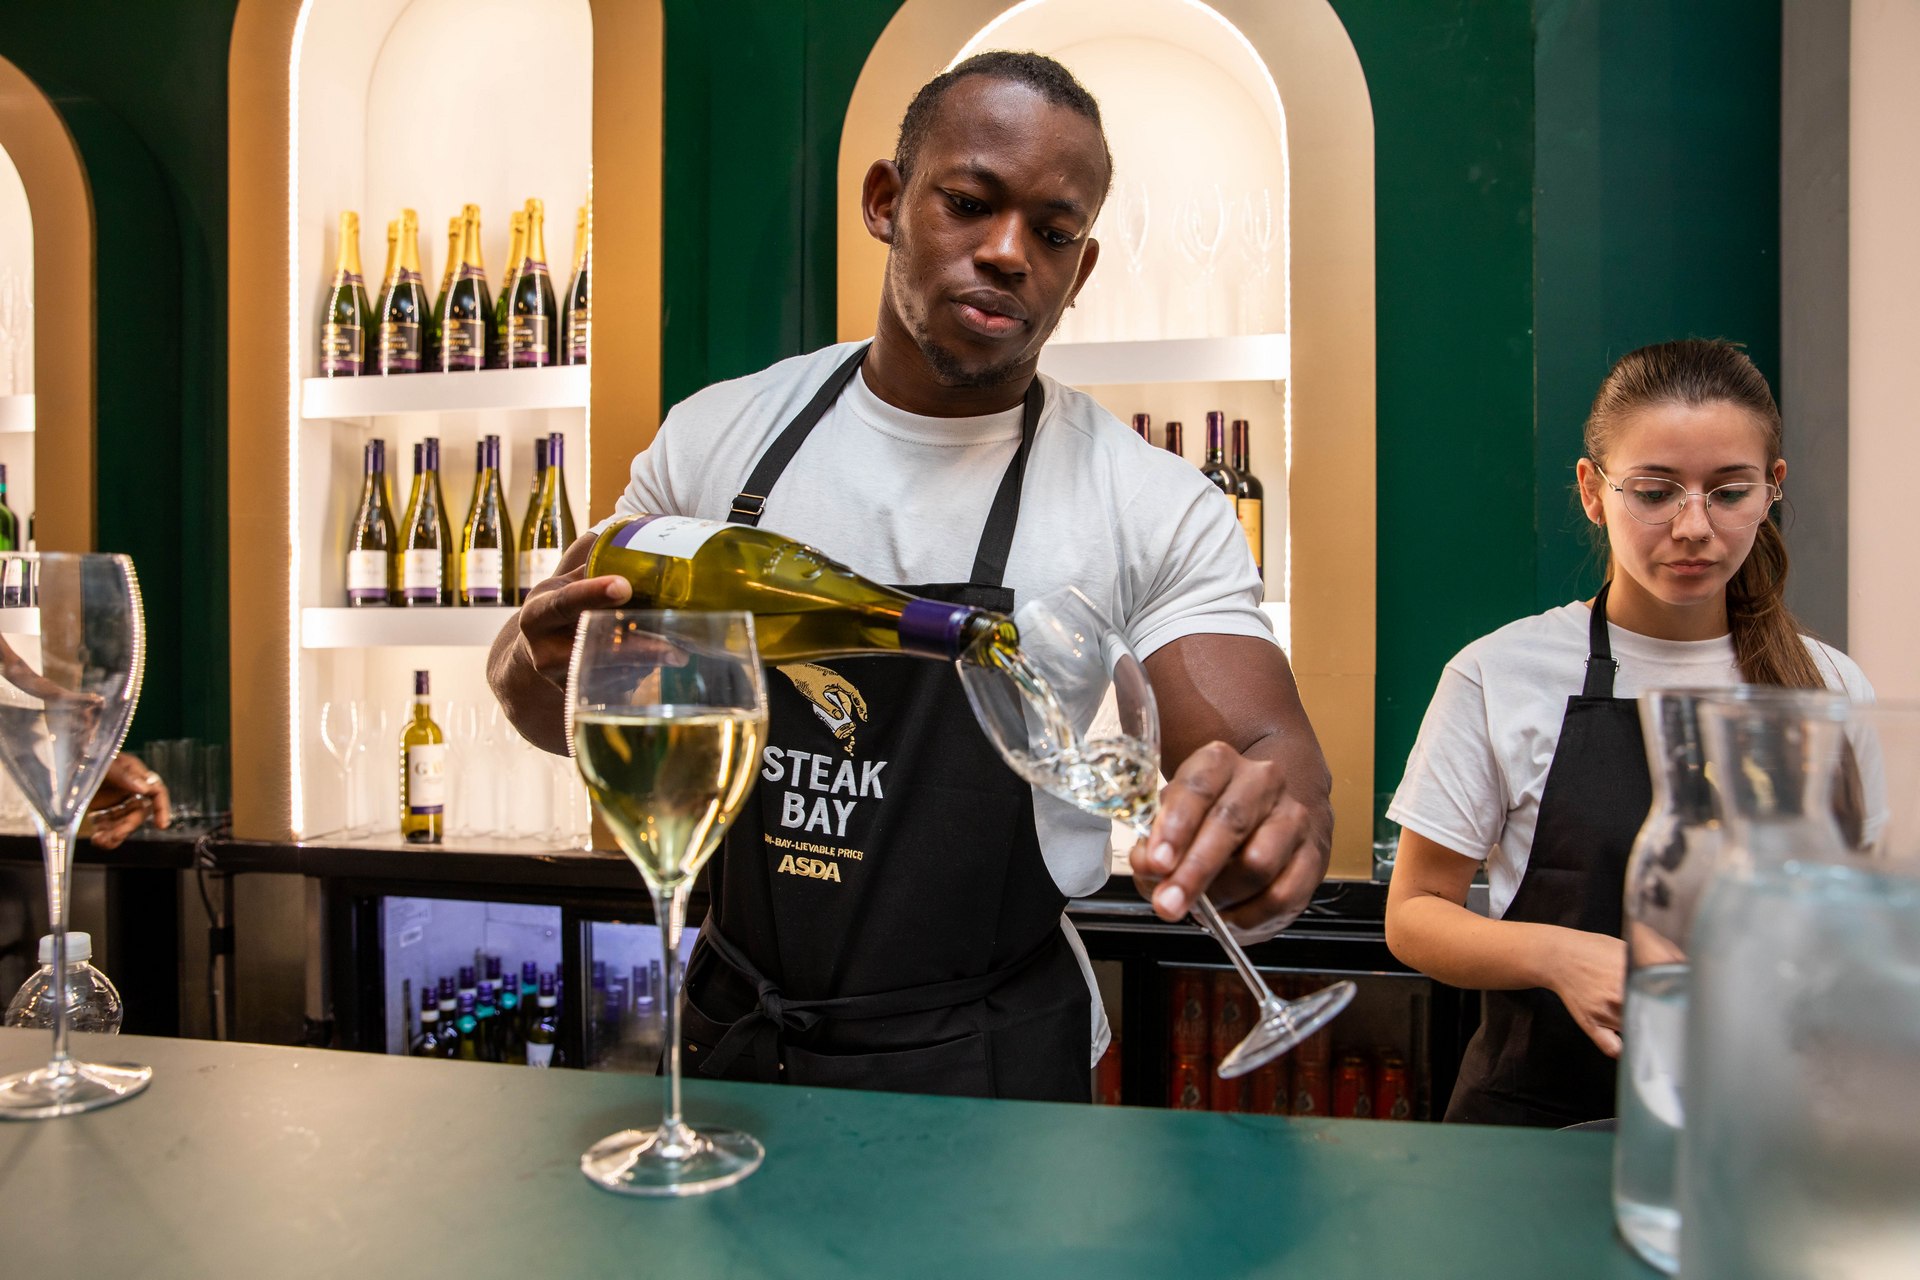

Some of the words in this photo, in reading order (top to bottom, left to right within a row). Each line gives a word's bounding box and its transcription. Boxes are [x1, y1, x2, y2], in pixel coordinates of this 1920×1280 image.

[761, 745, 888, 799] STEAK
[780, 791, 858, 838] BAY
[777, 854, 842, 883] ASDA
